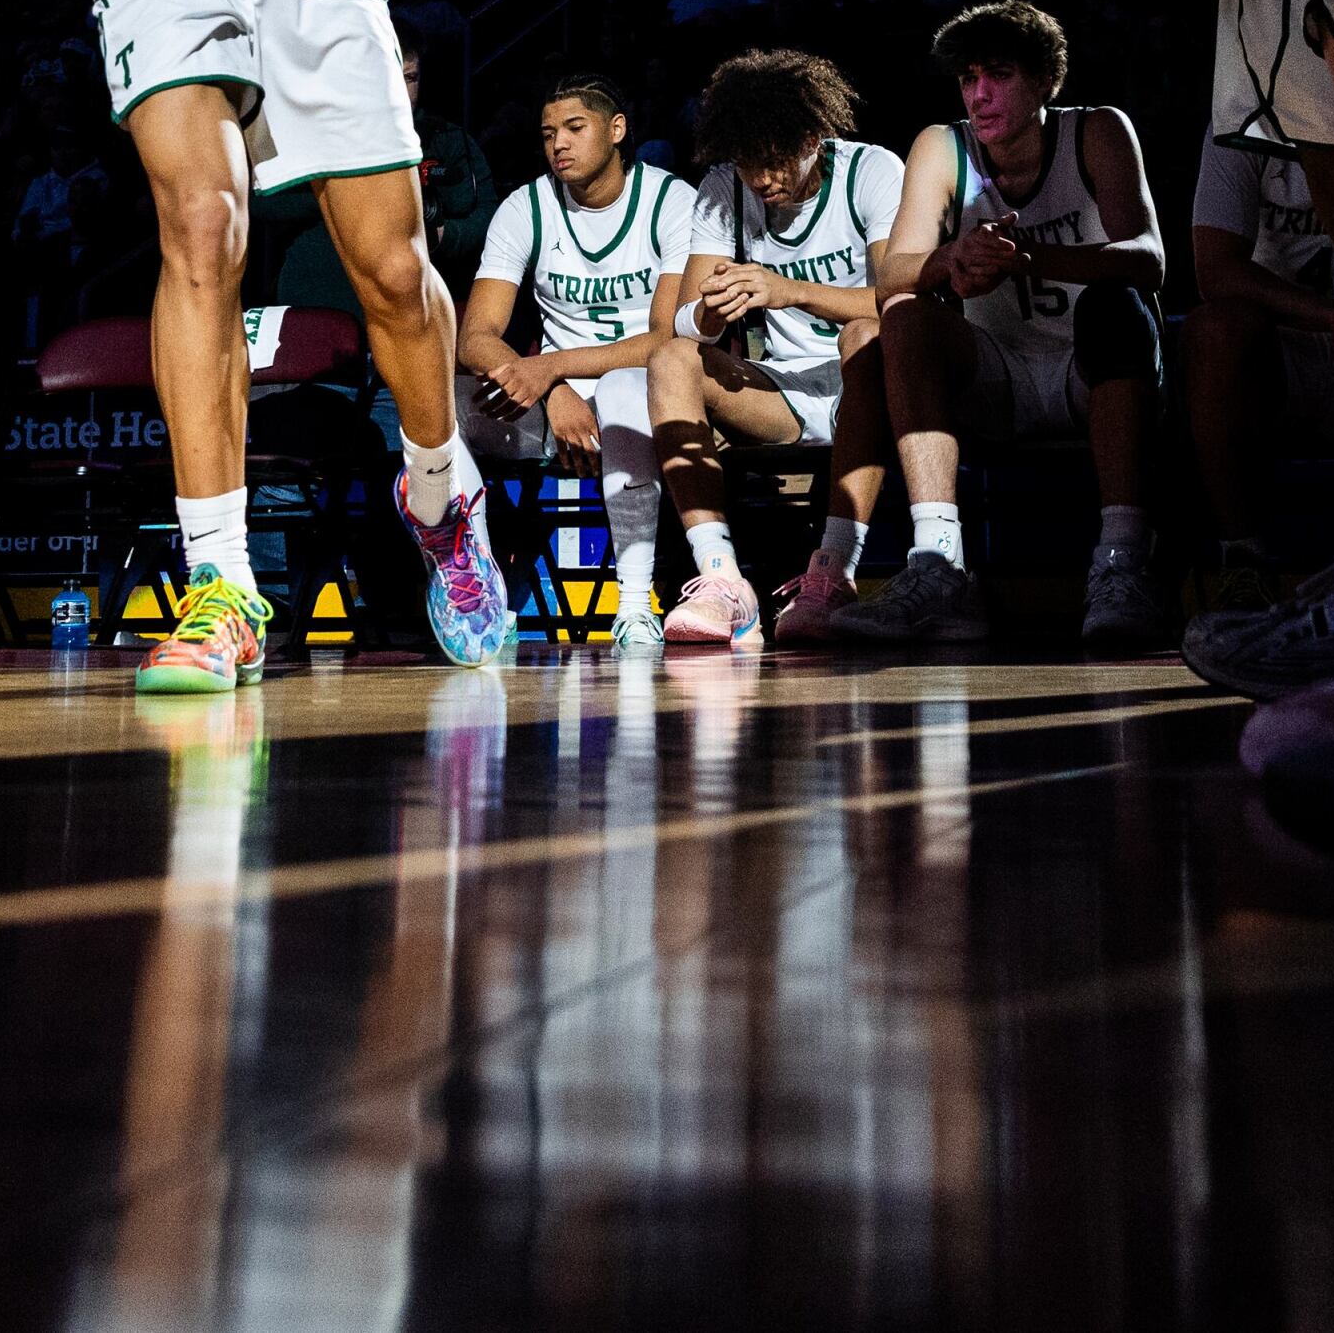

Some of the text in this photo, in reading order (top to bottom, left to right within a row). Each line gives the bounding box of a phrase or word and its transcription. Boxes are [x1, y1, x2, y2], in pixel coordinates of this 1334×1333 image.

[115, 40, 134, 89] T
[548, 267, 652, 304] TRINITY
[587, 306, 625, 341] 5
